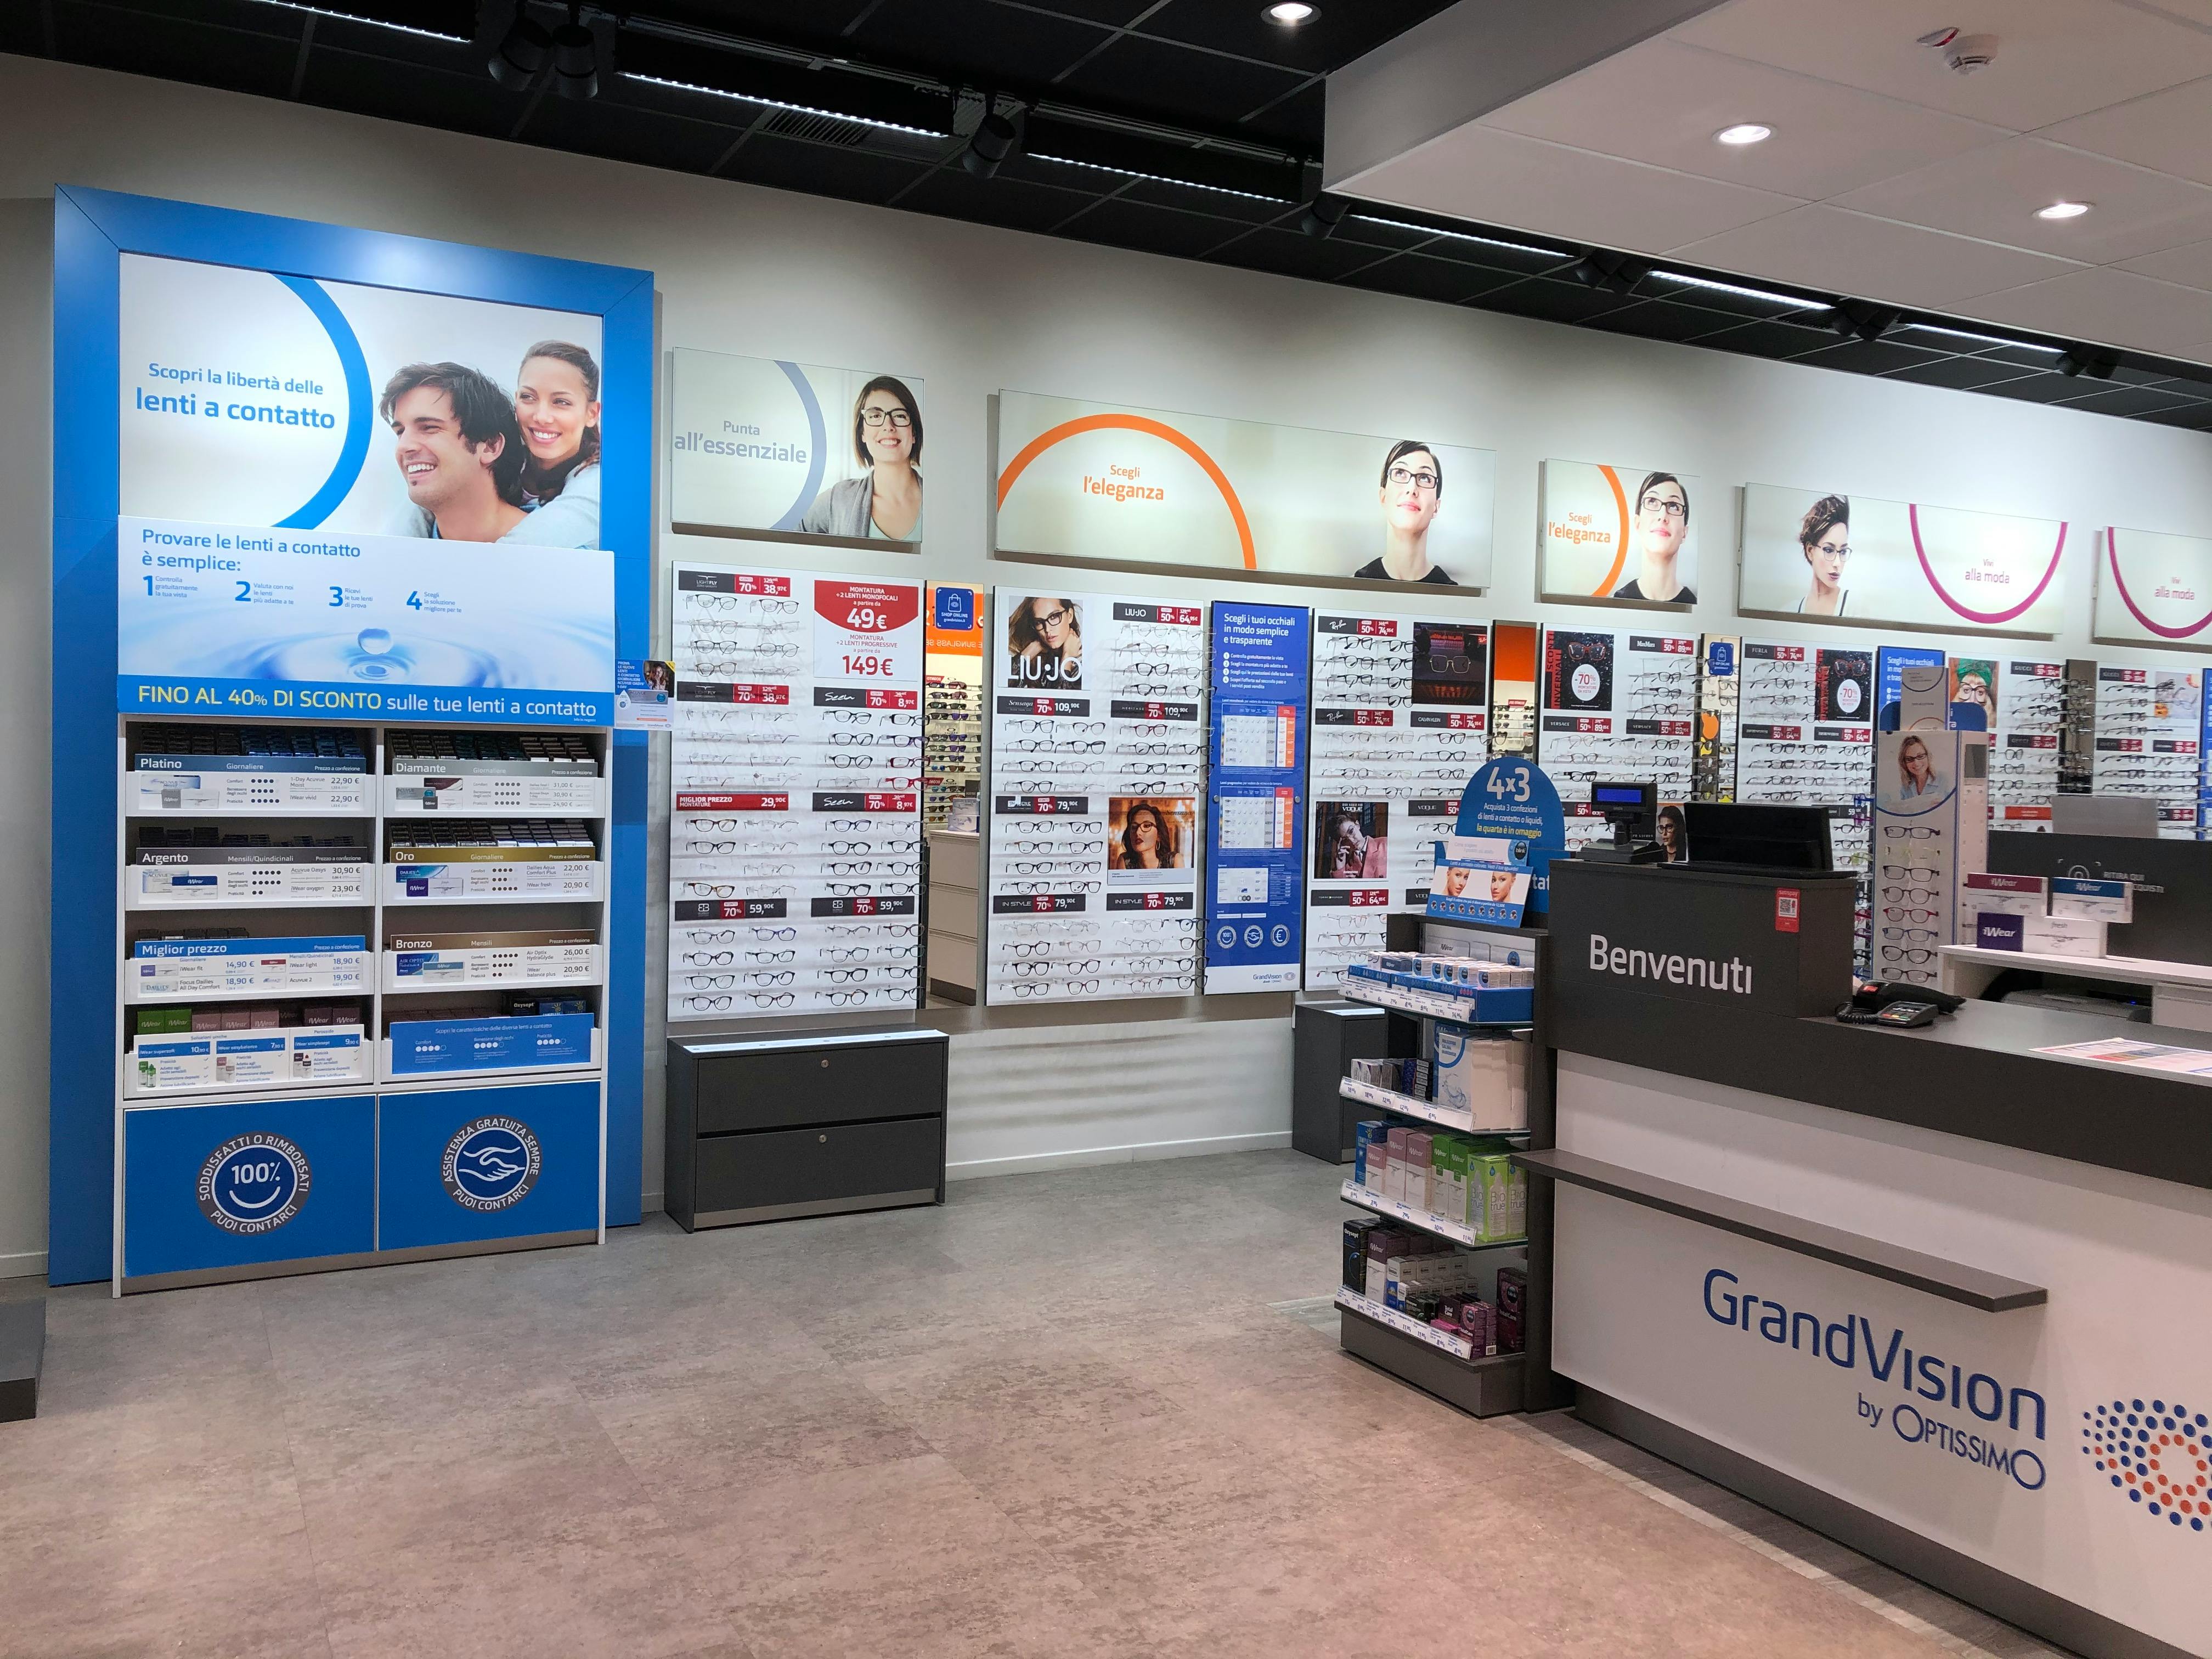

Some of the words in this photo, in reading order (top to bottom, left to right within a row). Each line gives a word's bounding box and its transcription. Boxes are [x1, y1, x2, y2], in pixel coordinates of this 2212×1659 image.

[149, 363, 202, 383] Scopri
[207, 369, 221, 384] la
[227, 371, 279, 390] libertà
[284, 379, 323, 395] delle
[137, 387, 195, 415] lenti
[205, 402, 219, 417] a
[227, 403, 335, 428] contatto
[724, 421, 760, 435] Punta
[674, 432, 806, 463] all'essenziale
[1110, 465, 1140, 480] Scegli
[1084, 476, 1164, 502] l'eleganza
[1569, 512, 1592, 526] Scegli
[1549, 522, 1611, 544] l'eleganza
[143, 529, 211, 548] Provare
[217, 534, 231, 549] le
[236, 535, 273, 552] lenti
[278, 541, 287, 552] a
[292, 543, 360, 557] contatto
[142, 551, 152, 566] è
[157, 555, 241, 573] semplice:
[1966, 568, 1981, 581] alla
[1984, 572, 2010, 583] moda
[143, 575, 153, 596] 1
[235, 580, 251, 602] 2
[739, 583, 757, 592] 70%
[329, 586, 343, 607] 3
[2155, 586, 2169, 597] alla
[2172, 589, 2194, 600] moda
[407, 591, 422, 610] 4
[1160, 613, 1175, 622] 50%
[1224, 613, 1246, 625] Scegli
[1251, 616, 1266, 624] tuoi
[1267, 617, 1295, 625] occhiali
[1224, 624, 1231, 633] in
[1233, 625, 1255, 634] modo
[1256, 628, 1289, 637] semplice
[1230, 636, 1273, 647] trasparente
[139, 685, 189, 704] FINO
[195, 687, 222, 705] AL
[228, 689, 268, 707] 40%
[274, 690, 293, 707] DI
[300, 691, 381, 710] SCONTO
[387, 694, 428, 712] sulle
[433, 697, 462, 713] tue
[468, 696, 504, 714] lenti
[510, 702, 520, 714] a
[526, 699, 596, 717] contatto
[871, 697, 887, 706] 70%
[1037, 704, 1052, 714] 70%
[140, 759, 182, 769] Platino
[396, 763, 446, 774] Diamante
[1487, 766, 1530, 802] 4x3
[1484, 803, 1505, 812] Acquista
[1511, 804, 1537, 813] confezioni
[1525, 817, 1543, 826] liquidi,
[1483, 826, 1502, 834] quarta
[1504, 825, 1507, 833] è
[1515, 828, 1541, 839] omaggio
[142, 853, 188, 865] Argento
[396, 851, 414, 861] Oro
[1991, 878, 2017, 887] iWear
[2076, 883, 2101, 892] iWear
[1036, 902, 1052, 911] 70%
[1983, 927, 2016, 937] iWear
[142, 945, 184, 957] Miglior
[187, 945, 227, 954] prezzo
[396, 940, 432, 949] Bronzo
[1590, 934, 1752, 994] Benvenuti
[443, 1126, 475, 1182] ASSISTENZA
[476, 1119, 527, 1137] GRATUITA
[524, 1135, 540, 1175] SEMPRE
[1409, 1147, 1424, 1156] iWear
[1434, 1148, 1448, 1157] iWear
[199, 1136, 250, 1201] SODDISFATTI
[253, 1135, 262, 1144] O
[266, 1135, 309, 1192] RIMBORSATI
[231, 1161, 280, 1184] 100%
[453, 1189, 477, 1207] PUOI
[478, 1184, 529, 1210] CONTARCI
[210, 1210, 238, 1231] PUOI
[239, 1205, 297, 1232] CONTARCI
[1344, 1229, 1359, 1238] Oxysept
[1703, 1268, 2046, 1441] GrandVision
[1858, 1392, 1883, 1428] by
